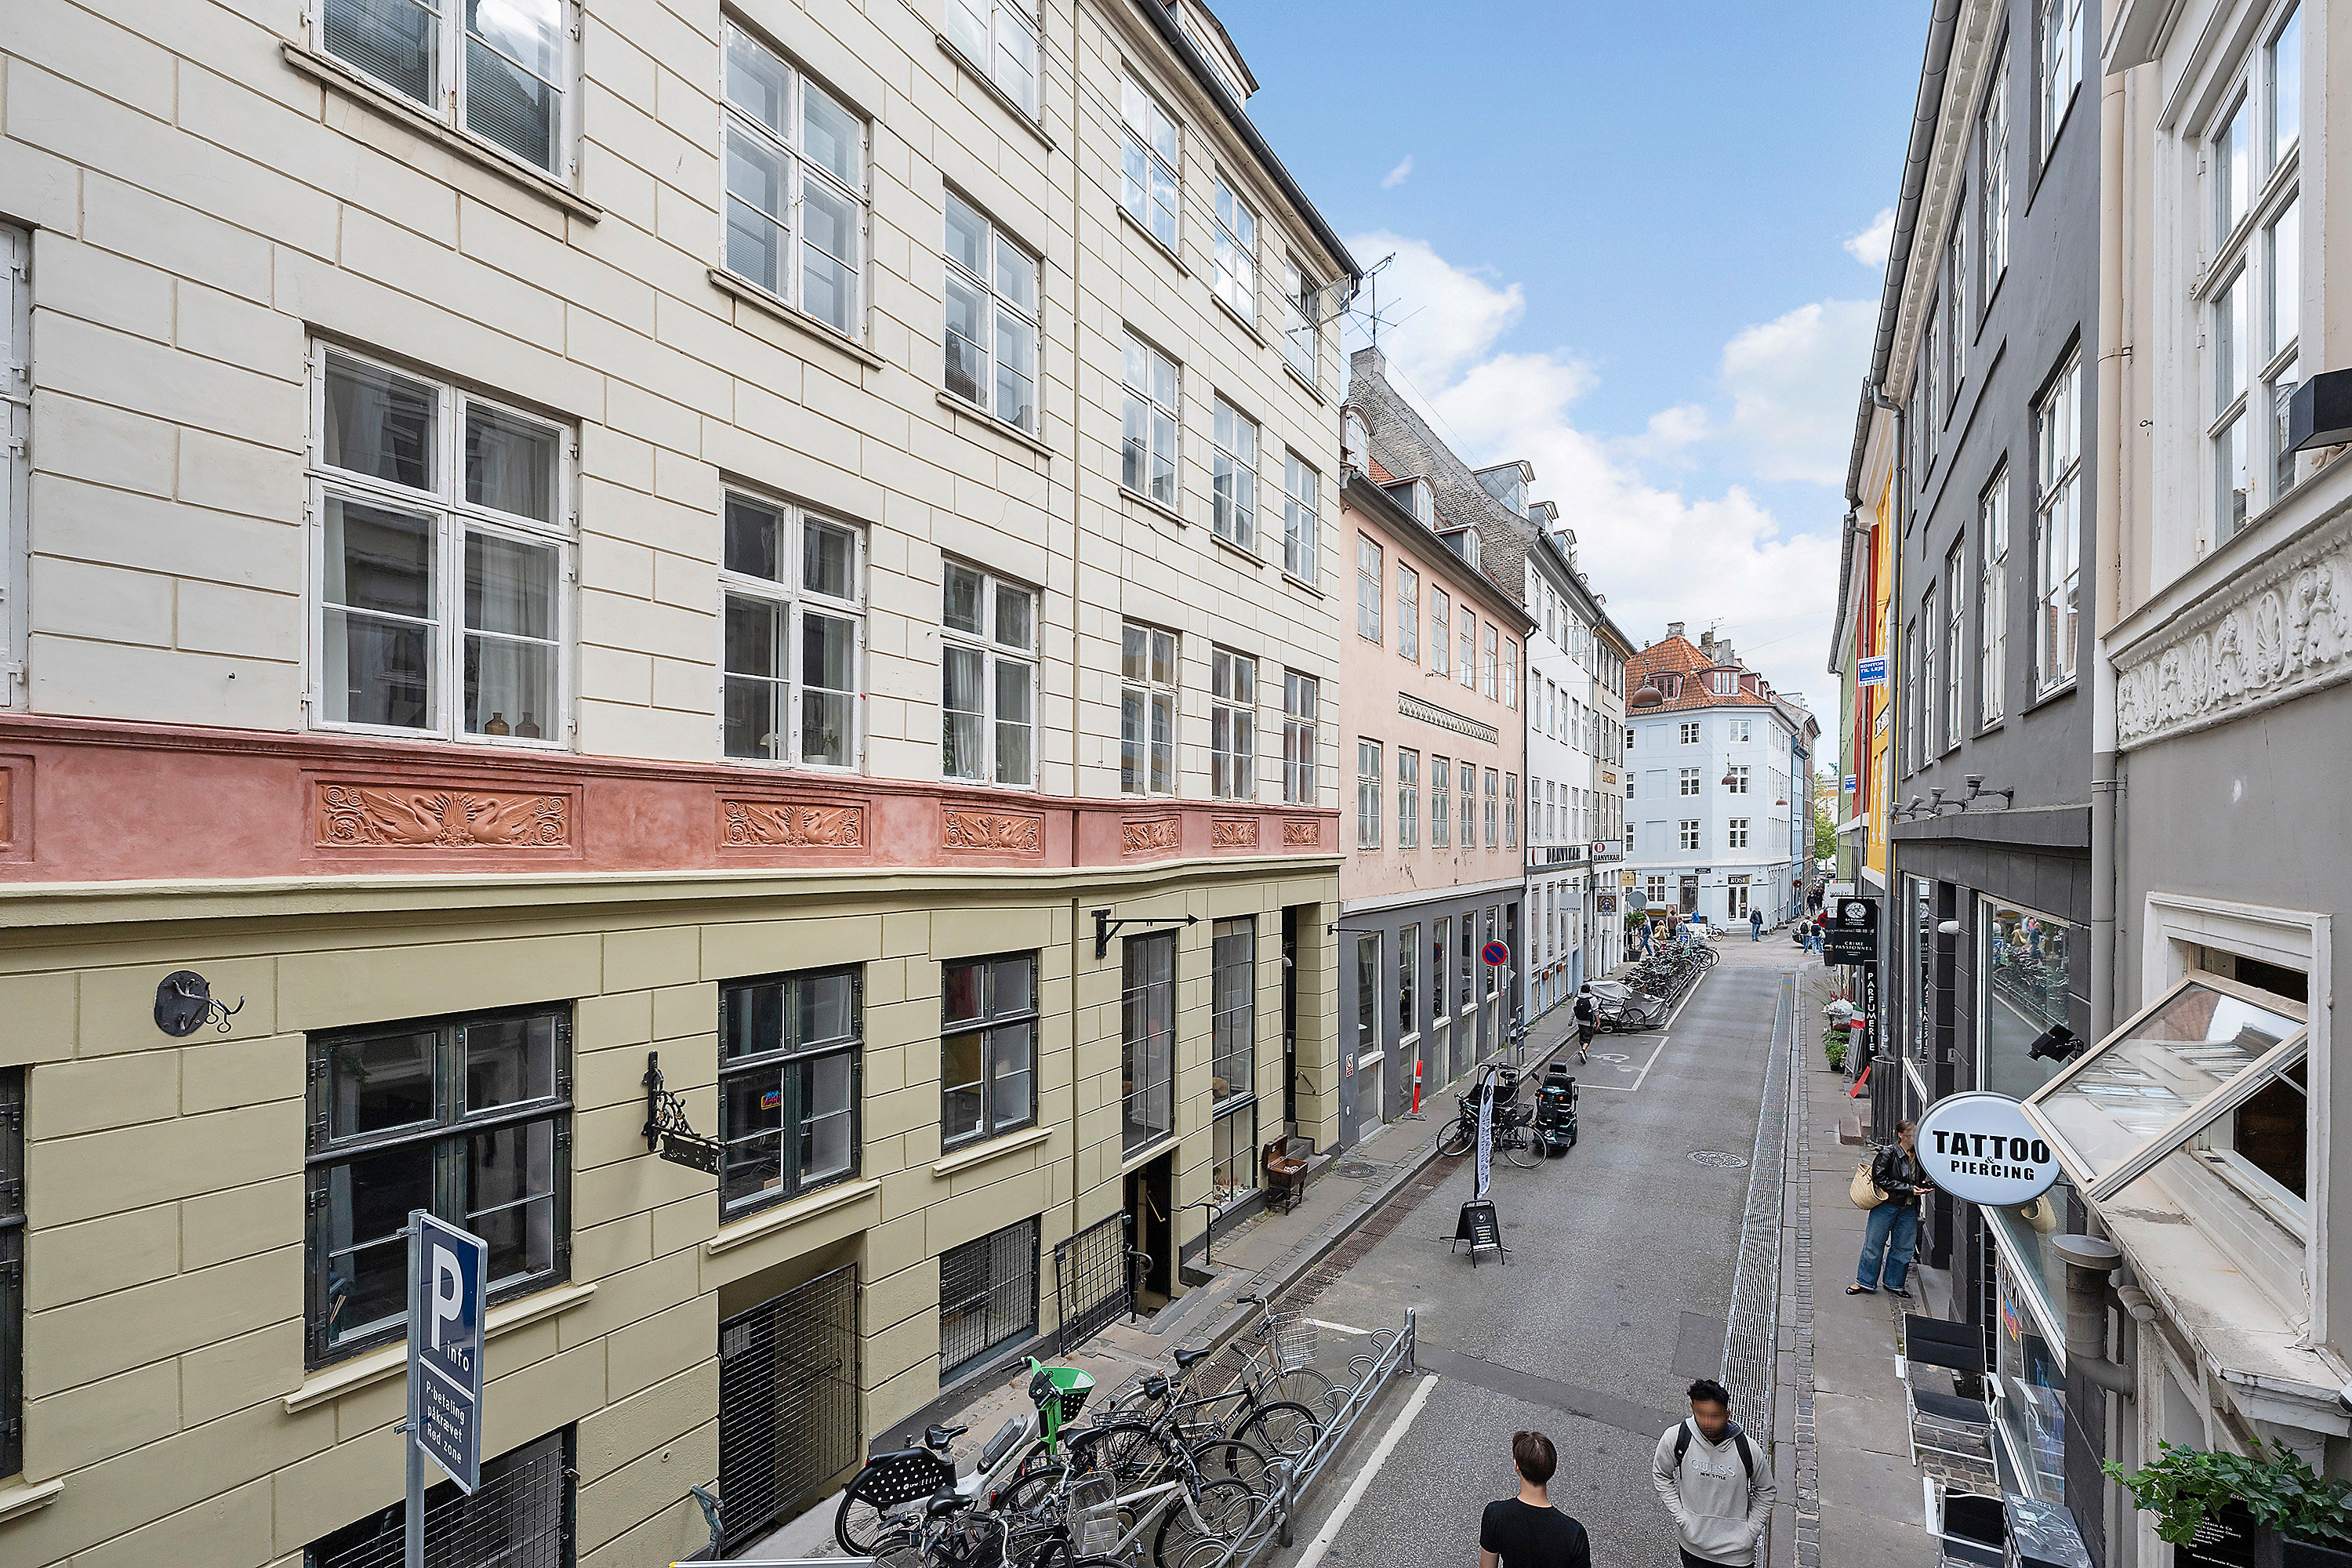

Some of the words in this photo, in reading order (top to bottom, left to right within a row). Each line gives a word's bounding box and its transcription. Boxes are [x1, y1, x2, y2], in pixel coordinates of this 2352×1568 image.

[1866, 971, 1877, 1051] PARFUMERIE
[1932, 1130, 2051, 1164] TATTOO
[1984, 1155, 1995, 1164] &
[1951, 1160, 2035, 1181] PIERCING
[431, 1243, 464, 1352] P
[446, 1339, 470, 1372] info
[426, 1379, 465, 1425] P-betaling
[427, 1403, 463, 1444] påkrævet
[427, 1423, 441, 1447] Rød
[443, 1443, 463, 1465] zone
[921, 1476, 937, 1486] ELLE
[1690, 1458, 1737, 1477] GUESS
